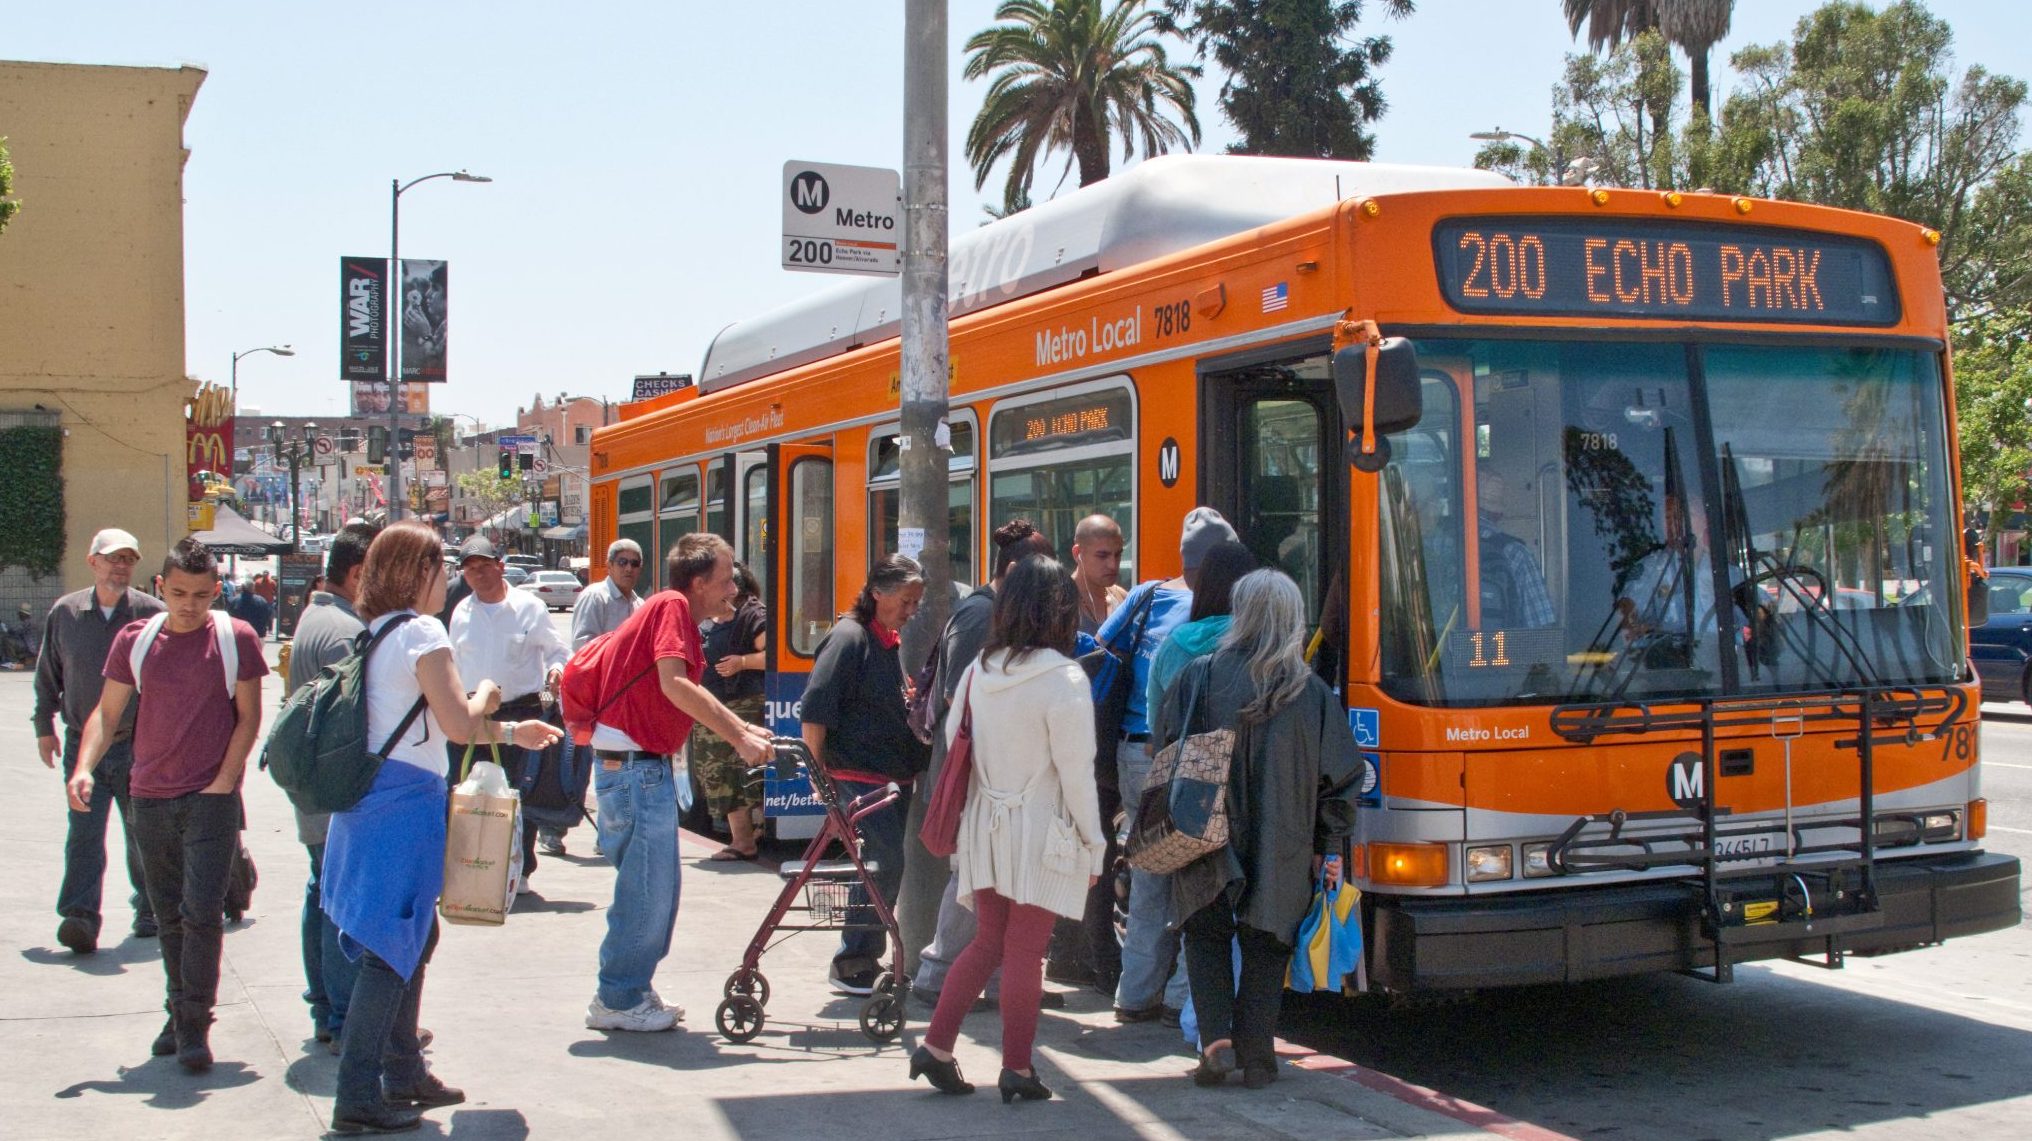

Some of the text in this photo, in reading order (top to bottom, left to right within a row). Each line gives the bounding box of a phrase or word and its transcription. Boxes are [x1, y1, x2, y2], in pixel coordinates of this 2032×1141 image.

[797, 179, 823, 207] M
[836, 208, 894, 230] Metro
[789, 239, 832, 264] 200
[1460, 232, 1824, 311] 200 ECHO PARK
[350, 278, 370, 338] WAR
[370, 280, 379, 339] PHOTOGRAPHY
[1154, 300, 1190, 339] 7818
[1036, 305, 1141, 367] Metro Local
[635, 379, 685, 389] CHECKS
[1025, 407, 1108, 440] 200 ECHO PARK
[1580, 433, 1617, 450] 7818
[1162, 446, 1177, 480] M
[1470, 631, 1509, 667] 11
[1446, 725, 1529, 741] Metro Local
[1674, 762, 1703, 799] M
